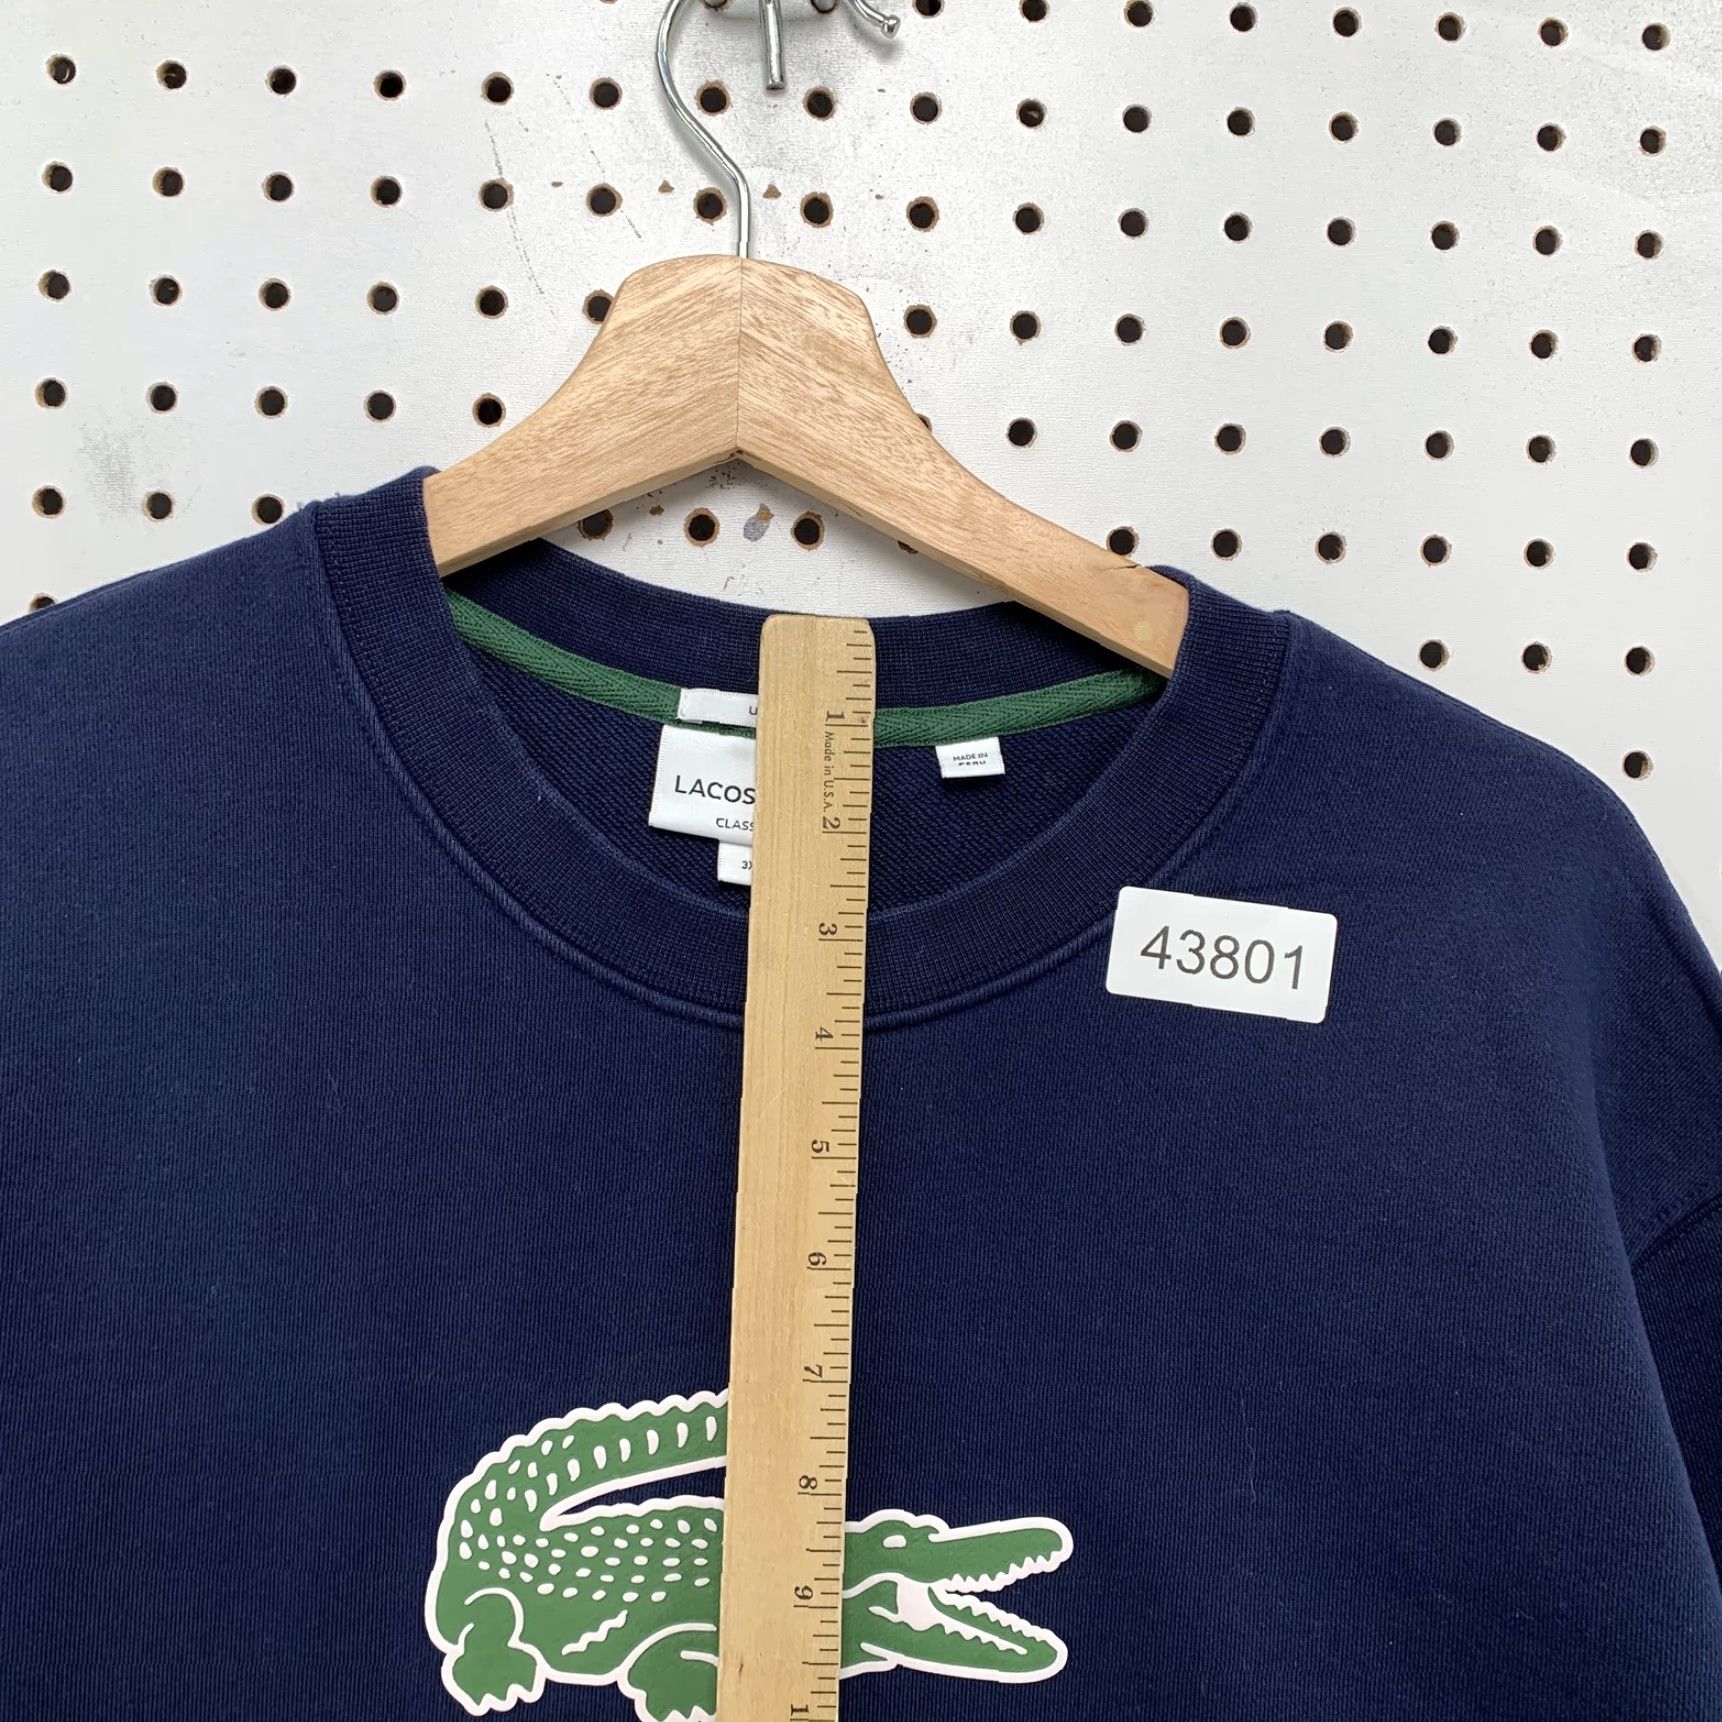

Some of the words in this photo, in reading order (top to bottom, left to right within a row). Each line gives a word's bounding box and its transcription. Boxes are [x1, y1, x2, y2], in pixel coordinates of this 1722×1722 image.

[826, 710, 845, 721] 1
[824, 731, 836, 762] Made
[953, 752, 976, 761] MADE
[824, 765, 835, 776] in
[823, 779, 834, 812] U.S.A.
[822, 816, 841, 830] 2
[819, 922, 838, 936] 3
[1140, 925, 1303, 990] 43801
[815, 1027, 834, 1041] 4
[811, 1139, 830, 1153] 5
[808, 1252, 827, 1266] 6
[803, 1364, 822, 1378] 7
[799, 1475, 818, 1490] 8
[794, 1585, 814, 1600] 9
